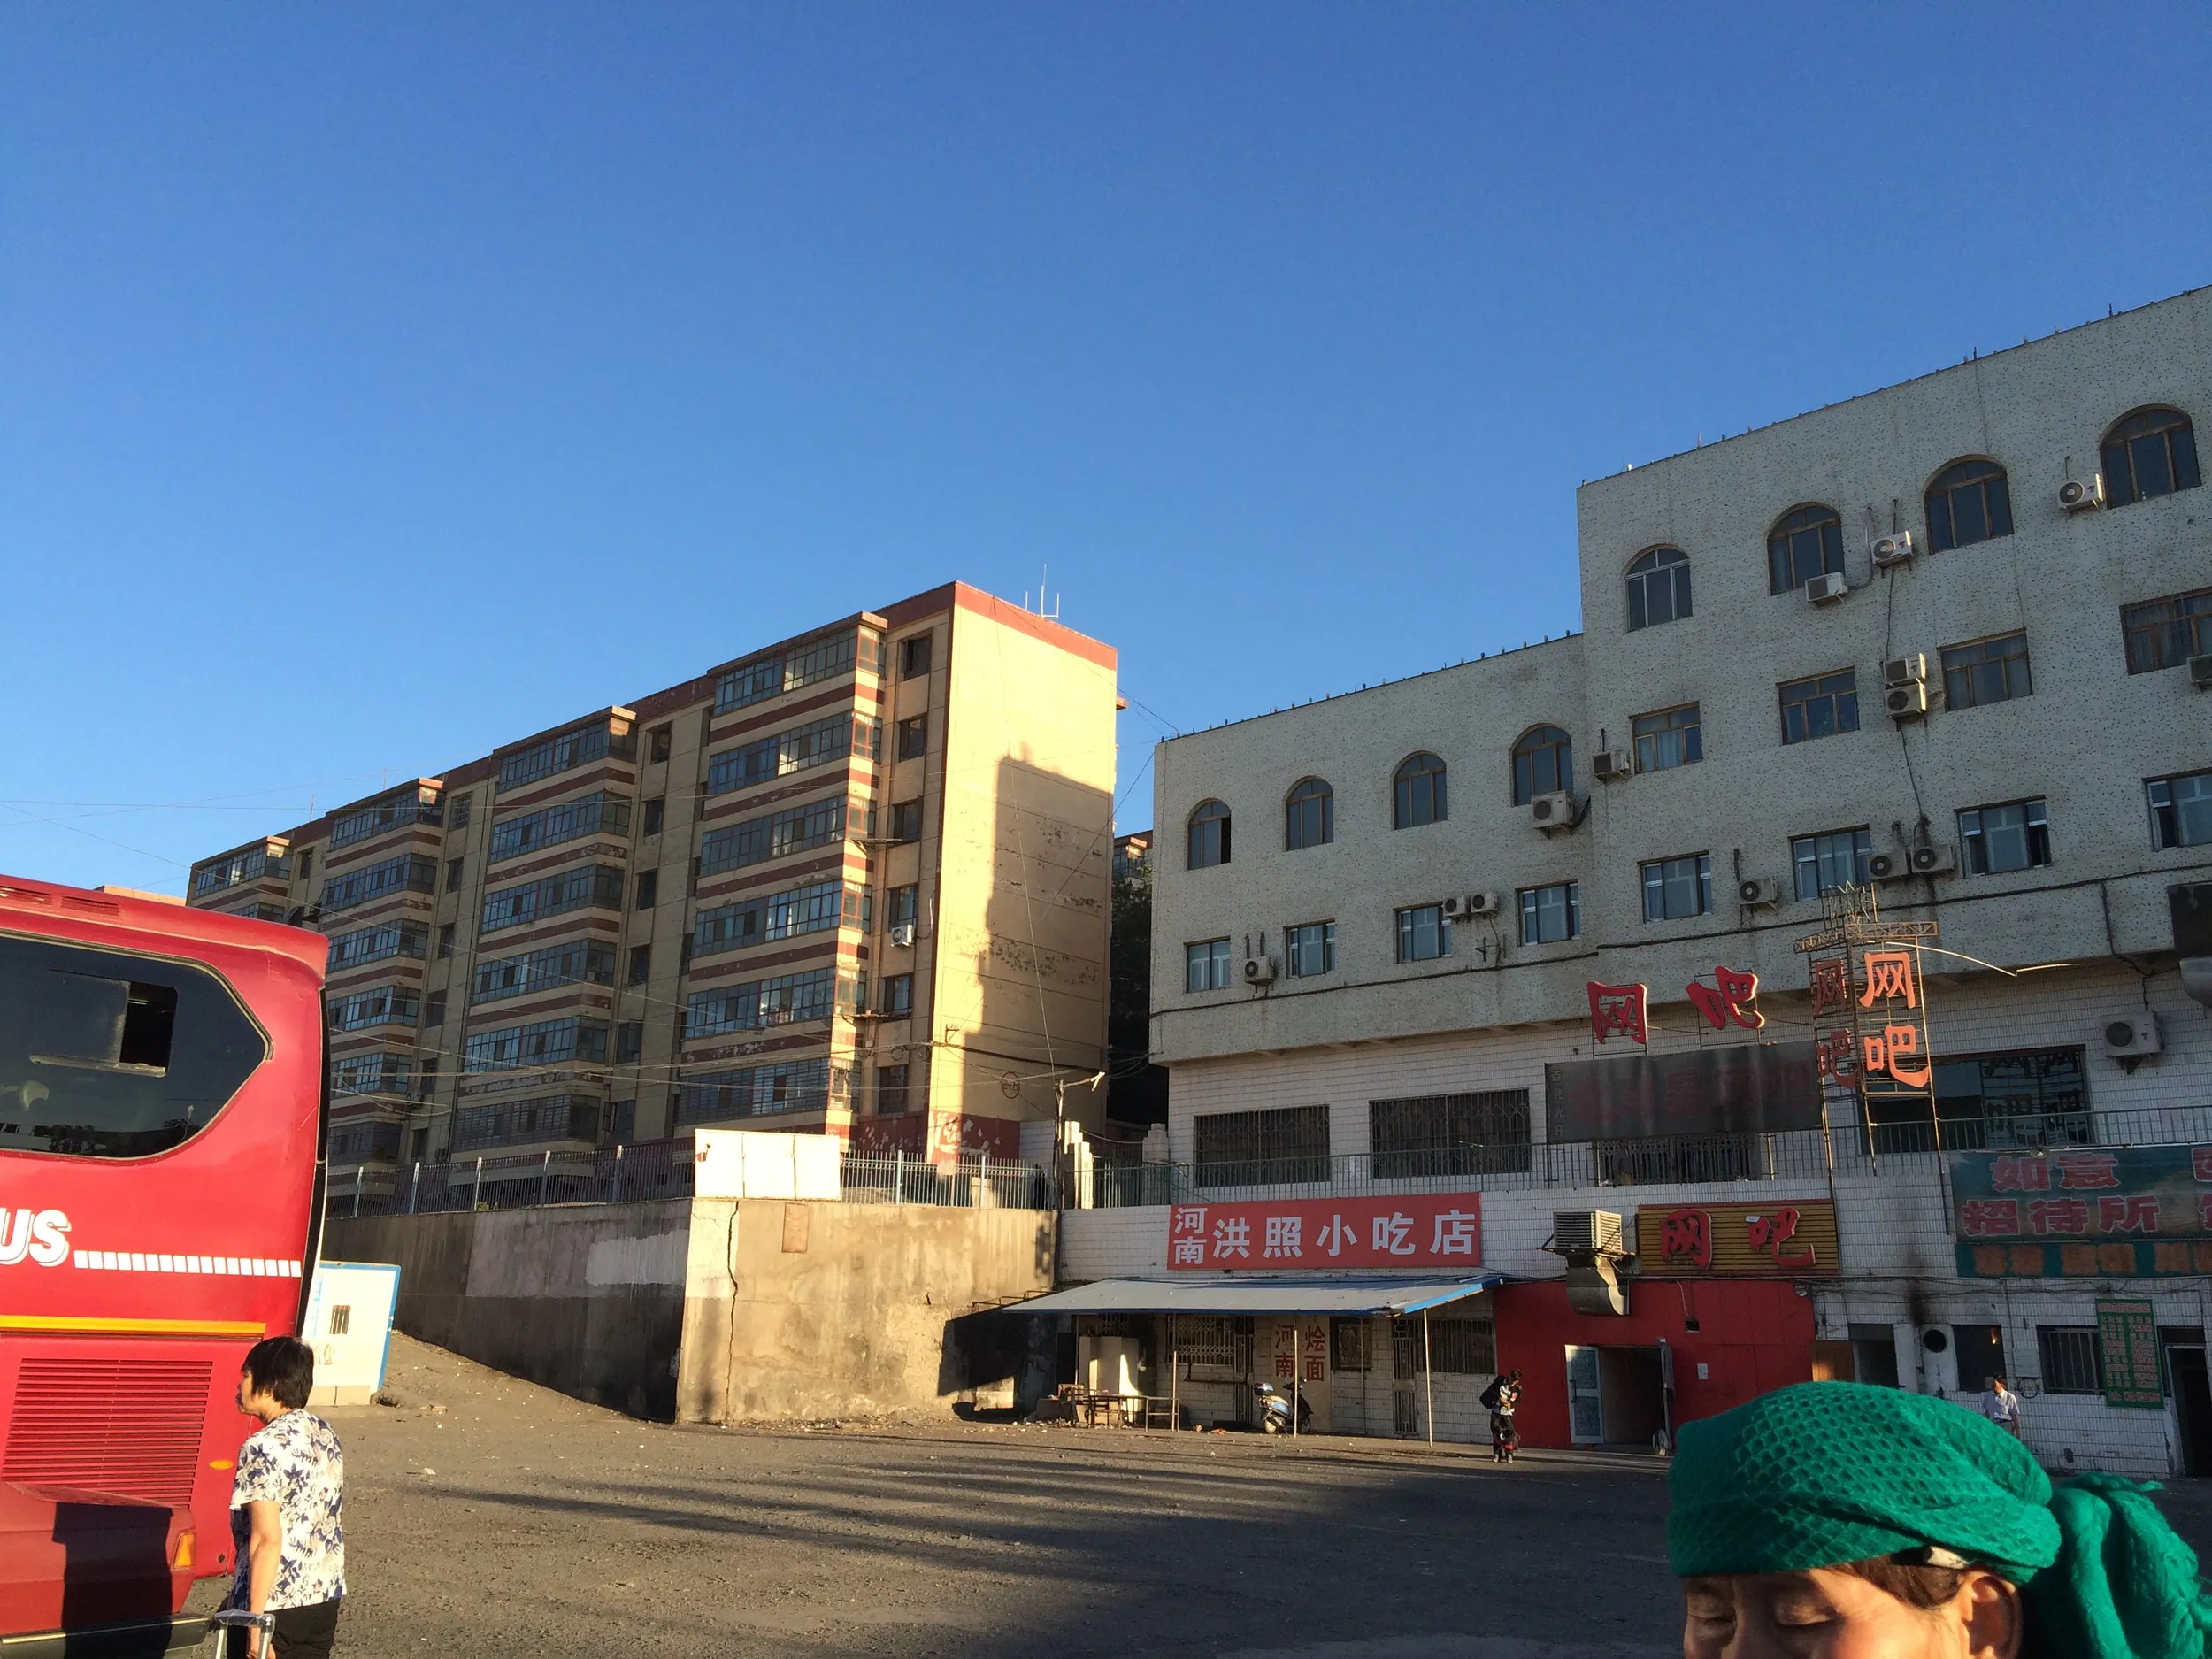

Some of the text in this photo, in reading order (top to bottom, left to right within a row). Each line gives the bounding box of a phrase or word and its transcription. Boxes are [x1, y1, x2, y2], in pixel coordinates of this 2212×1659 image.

[1586, 965, 1765, 1044] 网吧
[1859, 951, 1931, 1088] 网吧
[1990, 1152, 2121, 1192] 如意
[1173, 1207, 1208, 1265] 河南
[1212, 1209, 1476, 1259] 洪照小吃店
[1660, 1207, 1816, 1270] 网吧
[1961, 1195, 2160, 1237] 招待所
